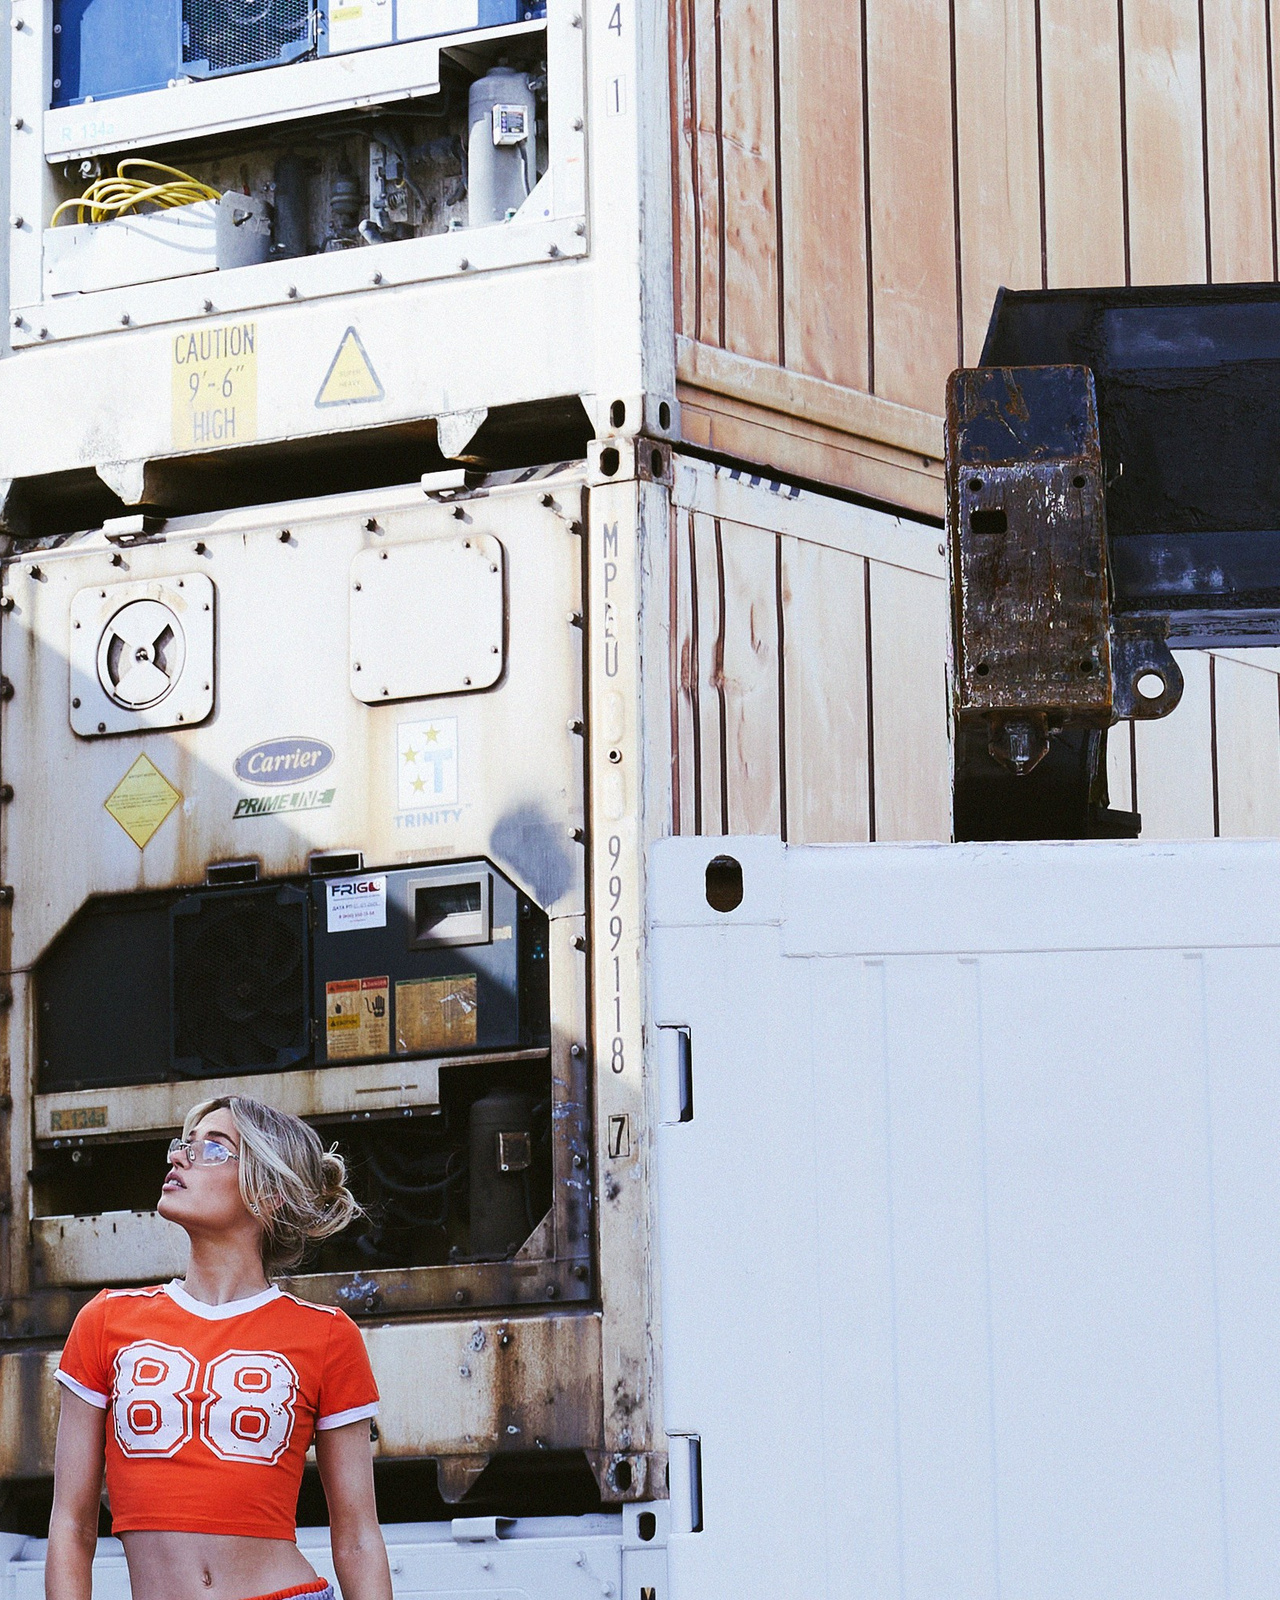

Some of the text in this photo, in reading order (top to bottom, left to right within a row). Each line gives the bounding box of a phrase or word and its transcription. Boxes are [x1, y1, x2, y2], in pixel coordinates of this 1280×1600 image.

[175, 324, 254, 365] CAUTION
[194, 407, 236, 443] HIGH
[247, 748, 322, 775] Carrier
[393, 808, 462, 829] TRINITY
[608, 835, 625, 1075] 999118
[611, 1116, 627, 1156] 7
[113, 1339, 300, 1466] 88
